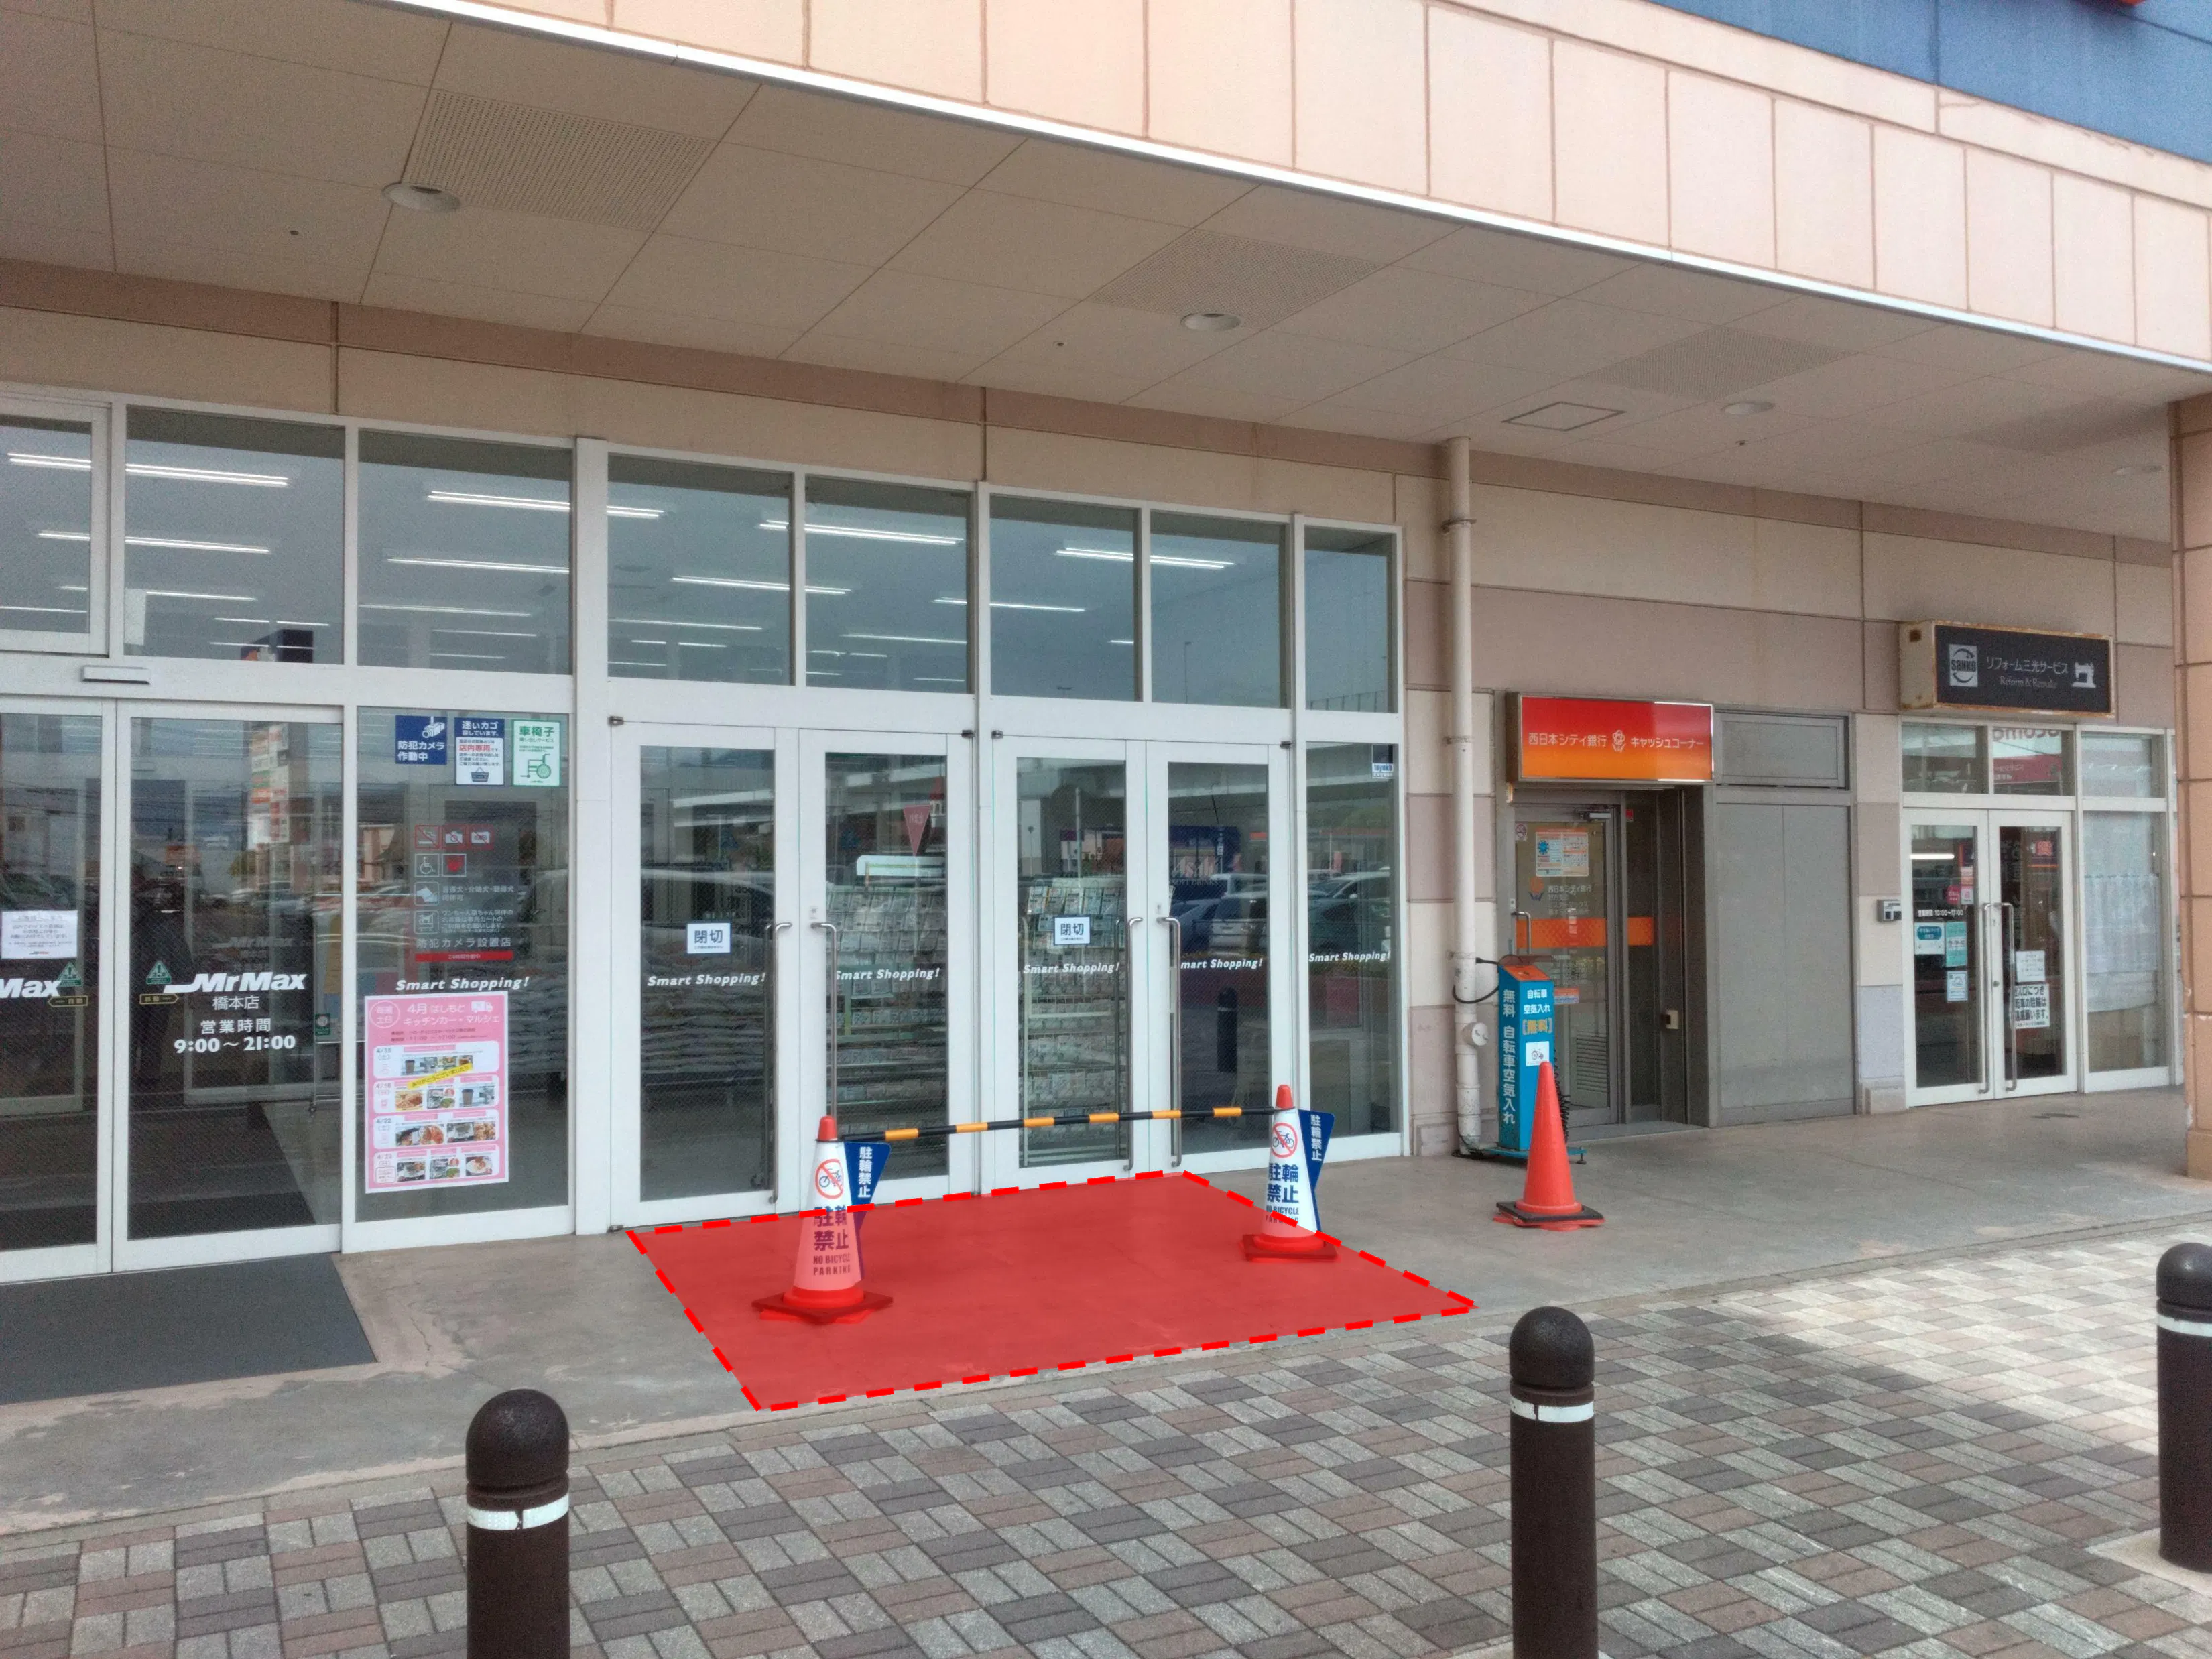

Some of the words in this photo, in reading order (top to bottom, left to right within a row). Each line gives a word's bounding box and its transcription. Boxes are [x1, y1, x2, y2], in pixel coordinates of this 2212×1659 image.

[1987, 657, 2069, 674] リフォーム三光サービス
[462, 721, 499, 730] 迷いカゴ
[519, 726, 555, 737] 車椅子
[397, 740, 445, 750] 防犯カメラ
[1528, 732, 1607, 747] 西日本シティ銀行
[1631, 737, 1704, 749] キャッシュコーナー
[397, 751, 428, 761] 作動中
[1060, 923, 1084, 936] 閉切
[417, 938, 511, 948] 防犯カメラ設置店
[694, 930, 723, 944] 閉切
[1308, 953, 1339, 962] Smart
[1341, 951, 1391, 962] Shopping!
[1024, 965, 1058, 974] Smart
[1062, 962, 1120, 975] Shopping!
[1181, 960, 1207, 969] mart
[1210, 959, 1263, 970] Shopping!
[647, 975, 692, 986] Smart
[696, 973, 765, 986] Shopping!
[837, 970, 873, 980] Smart
[876, 967, 940, 981] Shopping!
[163, 972, 308, 993] MrMax
[395, 979, 445, 991] Smart
[450, 977, 530, 991] Shopping!
[1527, 989, 1548, 999] 自転車
[212, 995, 260, 1011] 橋本店
[1503, 989, 1516, 1018] 無料
[1523, 1004, 1551, 1014] 空気入れ
[2015, 997, 2047, 1009] 転車の駐輪は
[200, 1018, 271, 1034] 営業時間
[404, 1014, 500, 1026] キッチンカー・マルシェ
[1503, 1026, 1516, 1125] 自転車空気入れ
[1310, 1114, 1322, 1162] 駐輪禁止
[858, 1146, 873, 1199] 駐輪禁止
[1269, 1162, 1298, 1183] 駐輪
[1267, 1184, 1299, 1203] 禁止
[813, 1205, 847, 1227] 駐輪
[1274, 1206, 1299, 1215] BICYCLE
[814, 1229, 849, 1251] 禁止
[813, 1255, 824, 1265] NO
[825, 1253, 850, 1264] BICYCLE
[813, 1264, 851, 1276] PARKING
